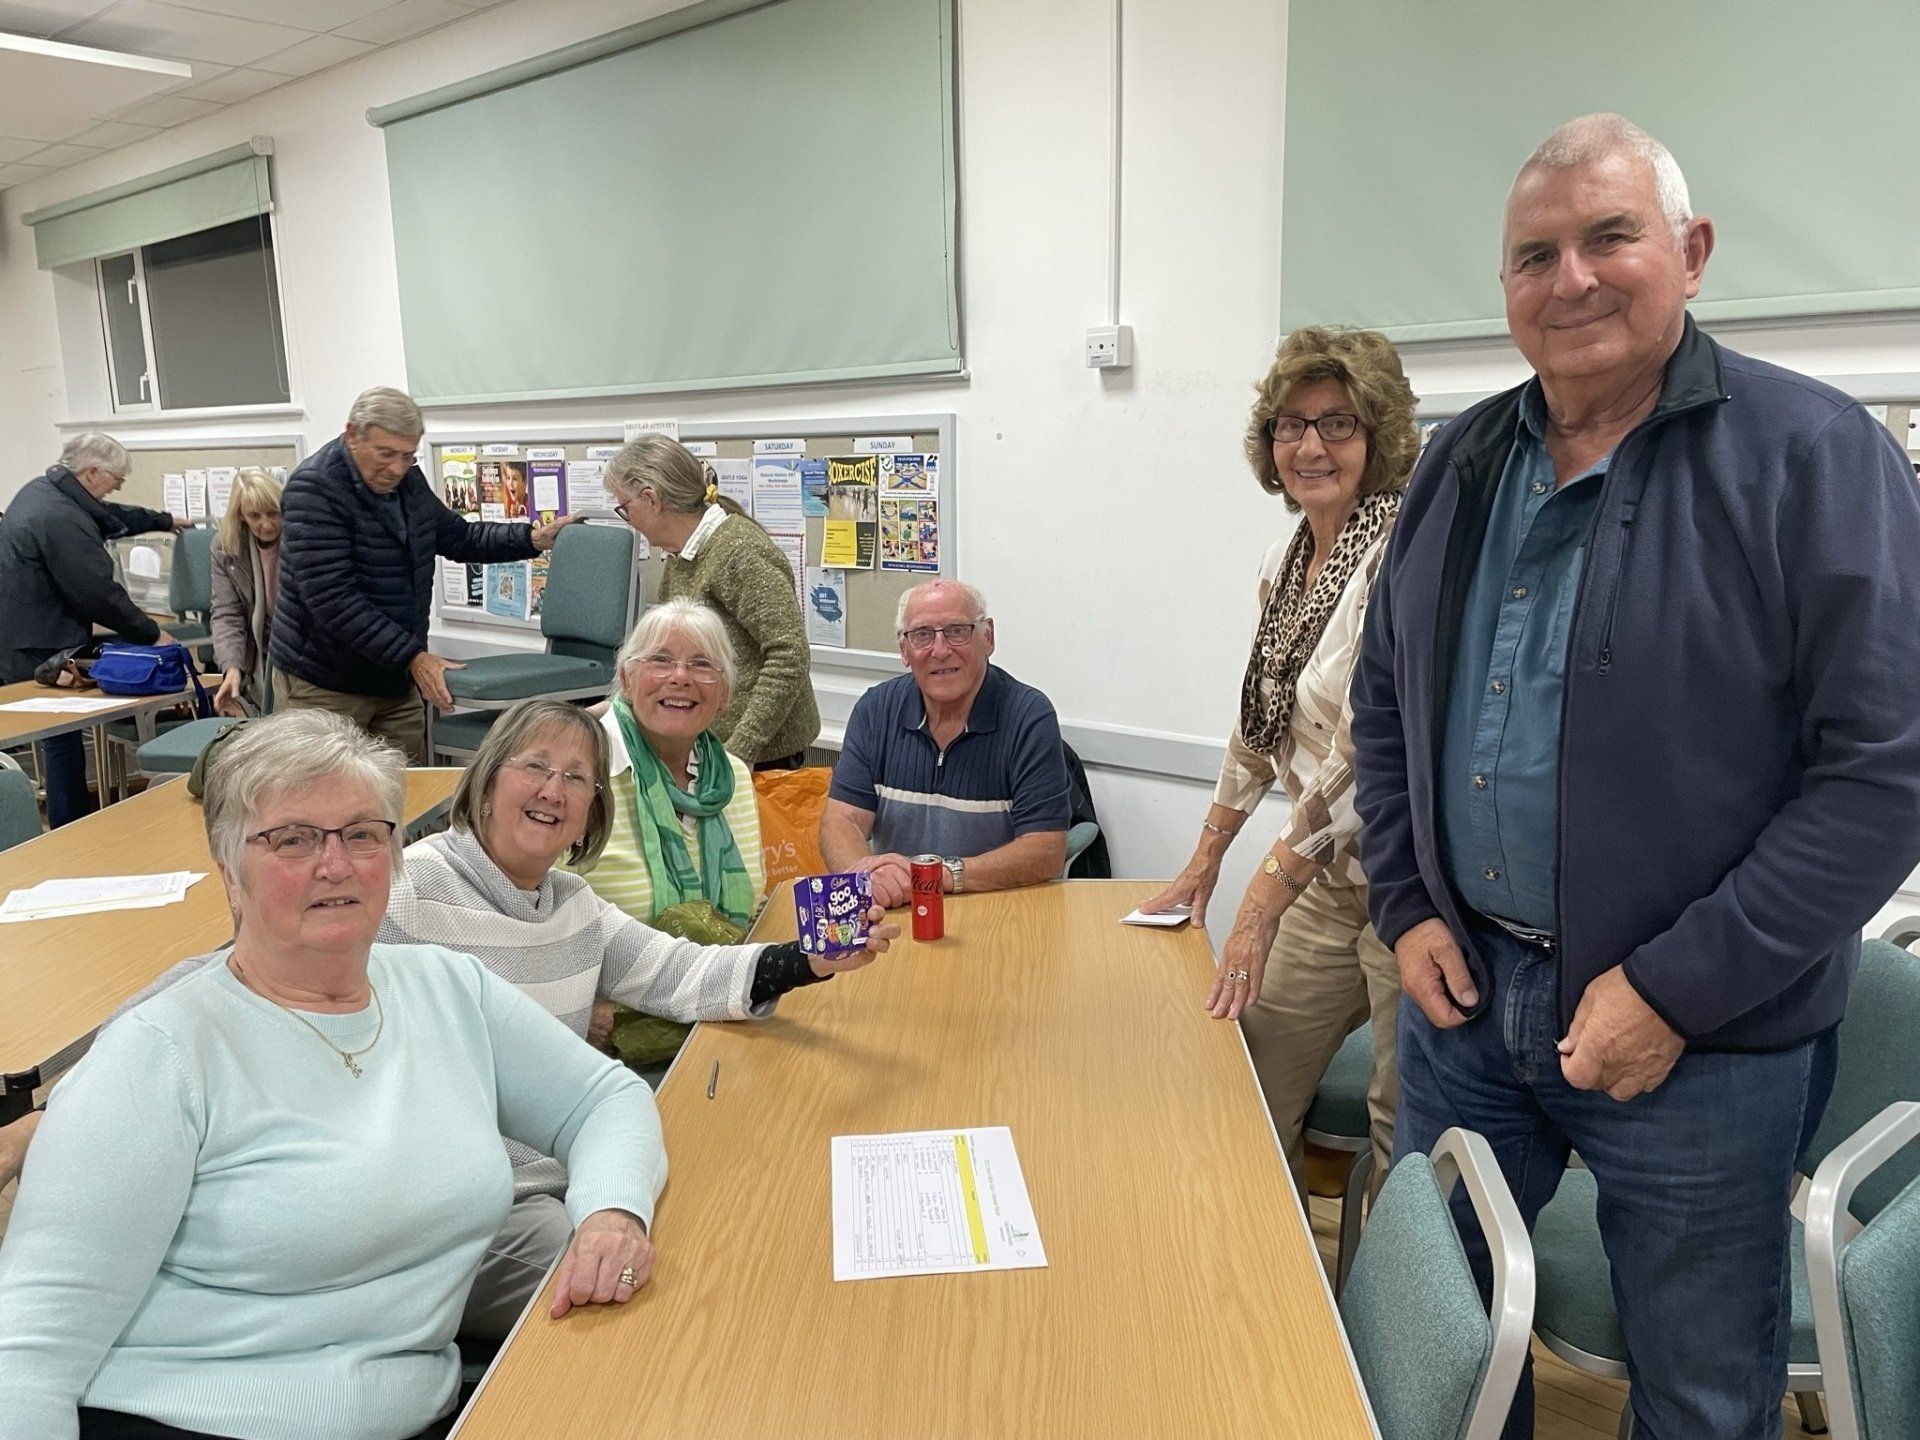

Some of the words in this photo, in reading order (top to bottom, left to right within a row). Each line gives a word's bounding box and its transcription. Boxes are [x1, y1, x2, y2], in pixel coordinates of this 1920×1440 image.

[870, 441, 896, 449] SUNDAY
[828, 894, 859, 916] heads
[830, 886, 851, 906] goo
